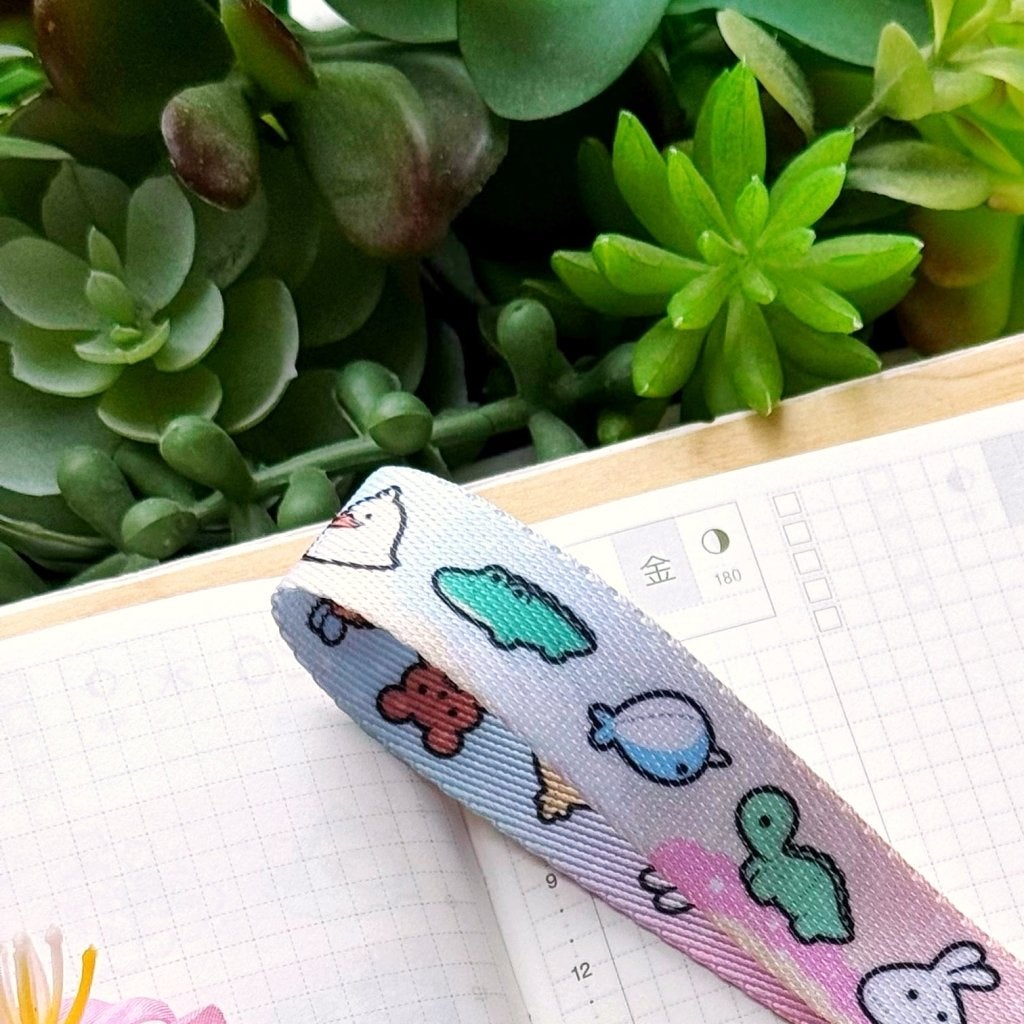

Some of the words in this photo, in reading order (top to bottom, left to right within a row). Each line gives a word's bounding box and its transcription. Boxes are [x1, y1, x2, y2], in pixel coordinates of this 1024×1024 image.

[639, 555, 677, 587] 金
[714, 568, 742, 587] 180
[545, 873, 558, 889] 9
[571, 962, 593, 982] 12
